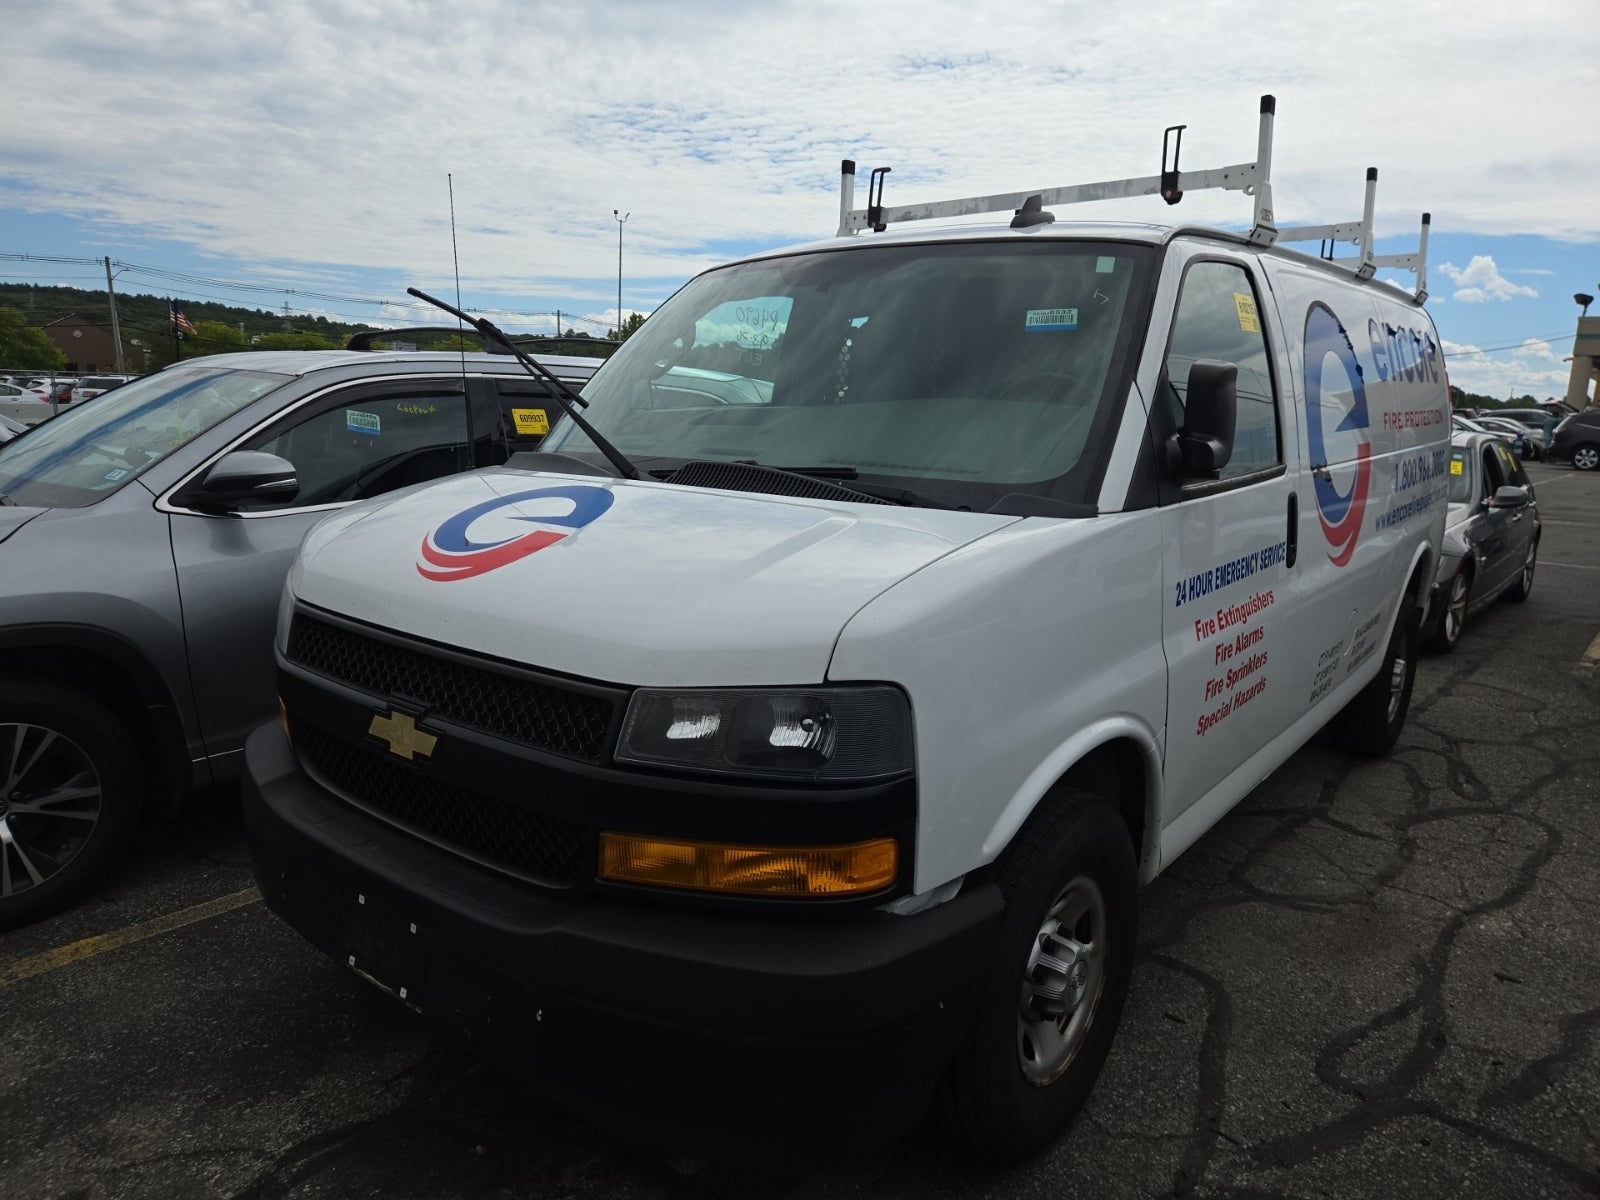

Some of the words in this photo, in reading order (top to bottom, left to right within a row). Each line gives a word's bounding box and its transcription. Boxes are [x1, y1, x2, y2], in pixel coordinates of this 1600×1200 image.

[1368, 317, 1439, 384] encore
[519, 414, 545, 424] 609937
[1383, 412, 1402, 430] FIRE
[1404, 409, 1443, 429] PROTECTION
[1175, 579, 1186, 607] 24
[1189, 570, 1213, 602] HOUR
[1215, 551, 1259, 590] EMERGENCY
[1259, 541, 1286, 570] SERVICE
[1195, 619, 1216, 642] Fire
[1217, 590, 1275, 630] Extinguishers
[1215, 644, 1233, 666] Fire
[1235, 624, 1264, 652] Alarms
[1205, 678, 1223, 702] Fire
[1226, 651, 1268, 691] Sprinklers
[1197, 702, 1232, 737] Special
[1234, 676, 1267, 710] Hazards
